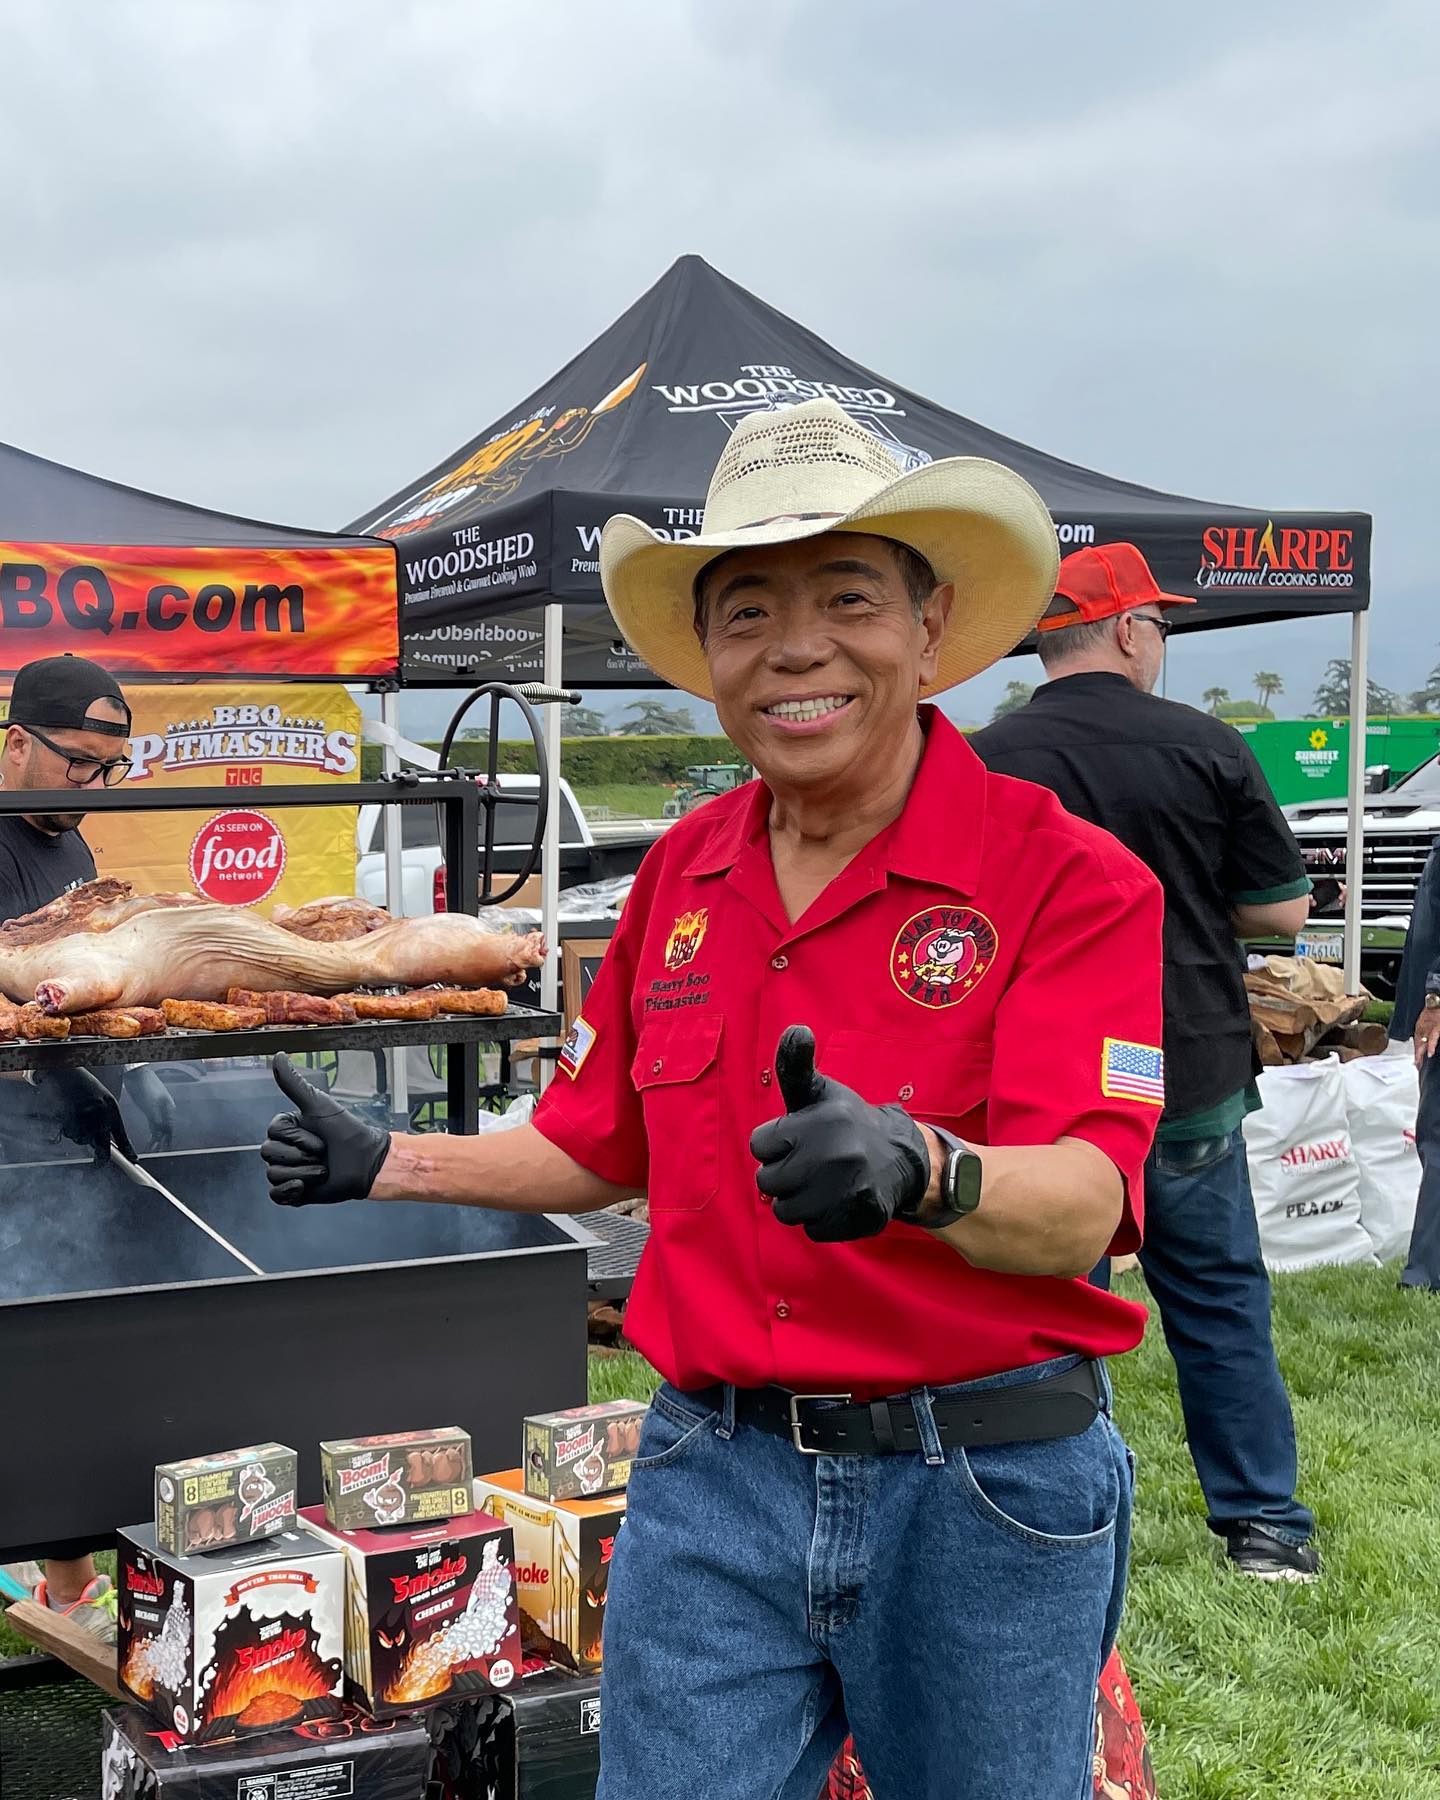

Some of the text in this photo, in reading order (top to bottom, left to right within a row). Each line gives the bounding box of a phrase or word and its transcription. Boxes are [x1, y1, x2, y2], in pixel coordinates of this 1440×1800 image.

[740, 365, 796, 379] THE
[652, 378, 896, 408] WOODSHED
[452, 525, 480, 546] THE
[1202, 519, 1353, 571] SHARPE
[405, 532, 534, 585] WOODSHED
[404, 588, 430, 605] Premium
[463, 574, 491, 591] Gourmet
[491, 563, 517, 585] Cooking
[518, 560, 537, 579] Wood
[1195, 561, 1353, 589] Gourmet COOKING WOOD
[213, 704, 283, 728] BBQ
[126, 731, 357, 780] PITMASTERS
[227, 769, 262, 785] TLC
[213, 823, 263, 833] AS SEEN ON
[198, 836, 280, 884] food
[218, 870, 264, 881] network
[557, 1429, 593, 1458] Boom!
[340, 1455, 389, 1486] Boom!
[186, 1486, 196, 1502] 8
[455, 1490, 465, 1506] 8
[390, 1555, 468, 1604] Smoke
[515, 1563, 550, 1585] moke
[414, 1597, 455, 1622] CHERRY
[235, 1628, 307, 1673] Smoke
